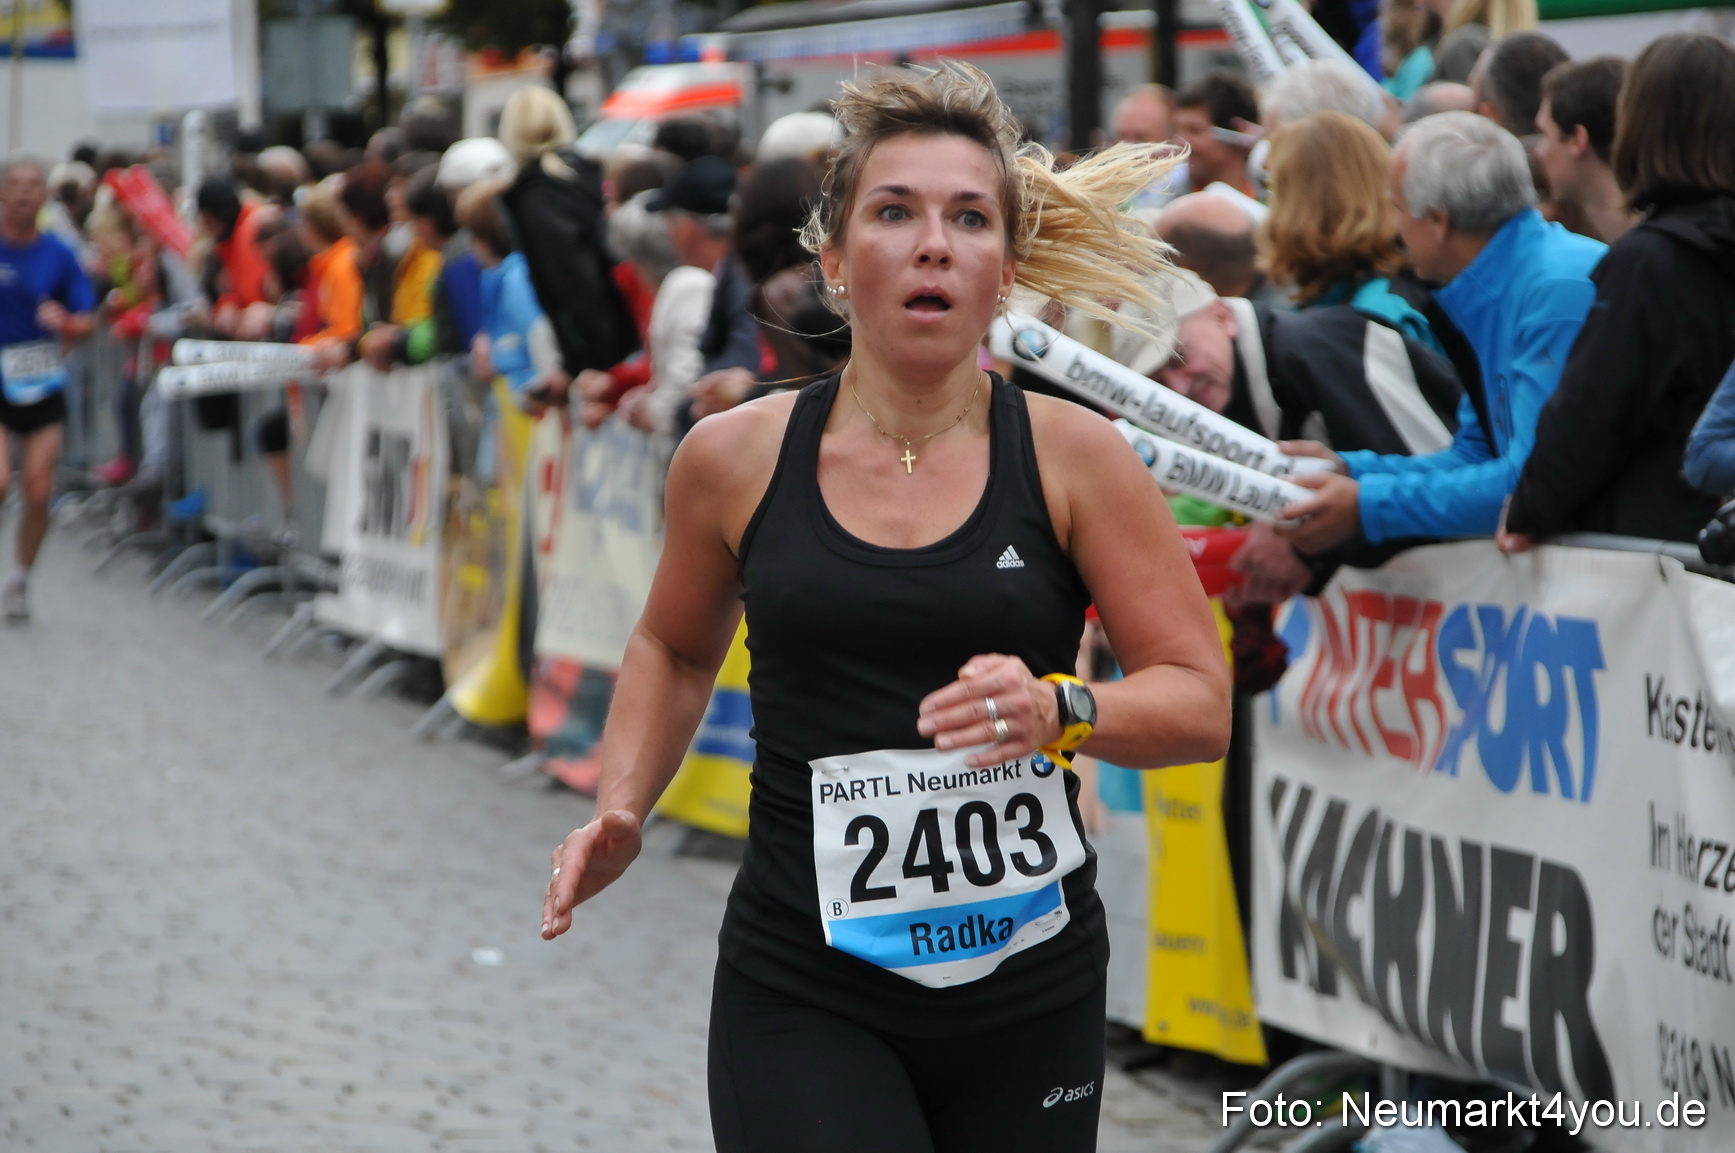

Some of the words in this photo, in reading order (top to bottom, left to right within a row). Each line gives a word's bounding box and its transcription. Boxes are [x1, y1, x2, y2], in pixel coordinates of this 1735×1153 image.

[1066, 352, 1295, 477] bmw-laufsportd
[996, 559, 1025, 568] adidas
[819, 777, 901, 804] PARTL
[907, 759, 1023, 793] Neumarkt
[844, 793, 1059, 903] 2403
[1649, 800, 1671, 871] Im
[833, 902, 842, 916] B
[909, 914, 1014, 956] Radka
[1684, 902, 1734, 983] Stadt
[1064, 1081, 1095, 1102] asics
